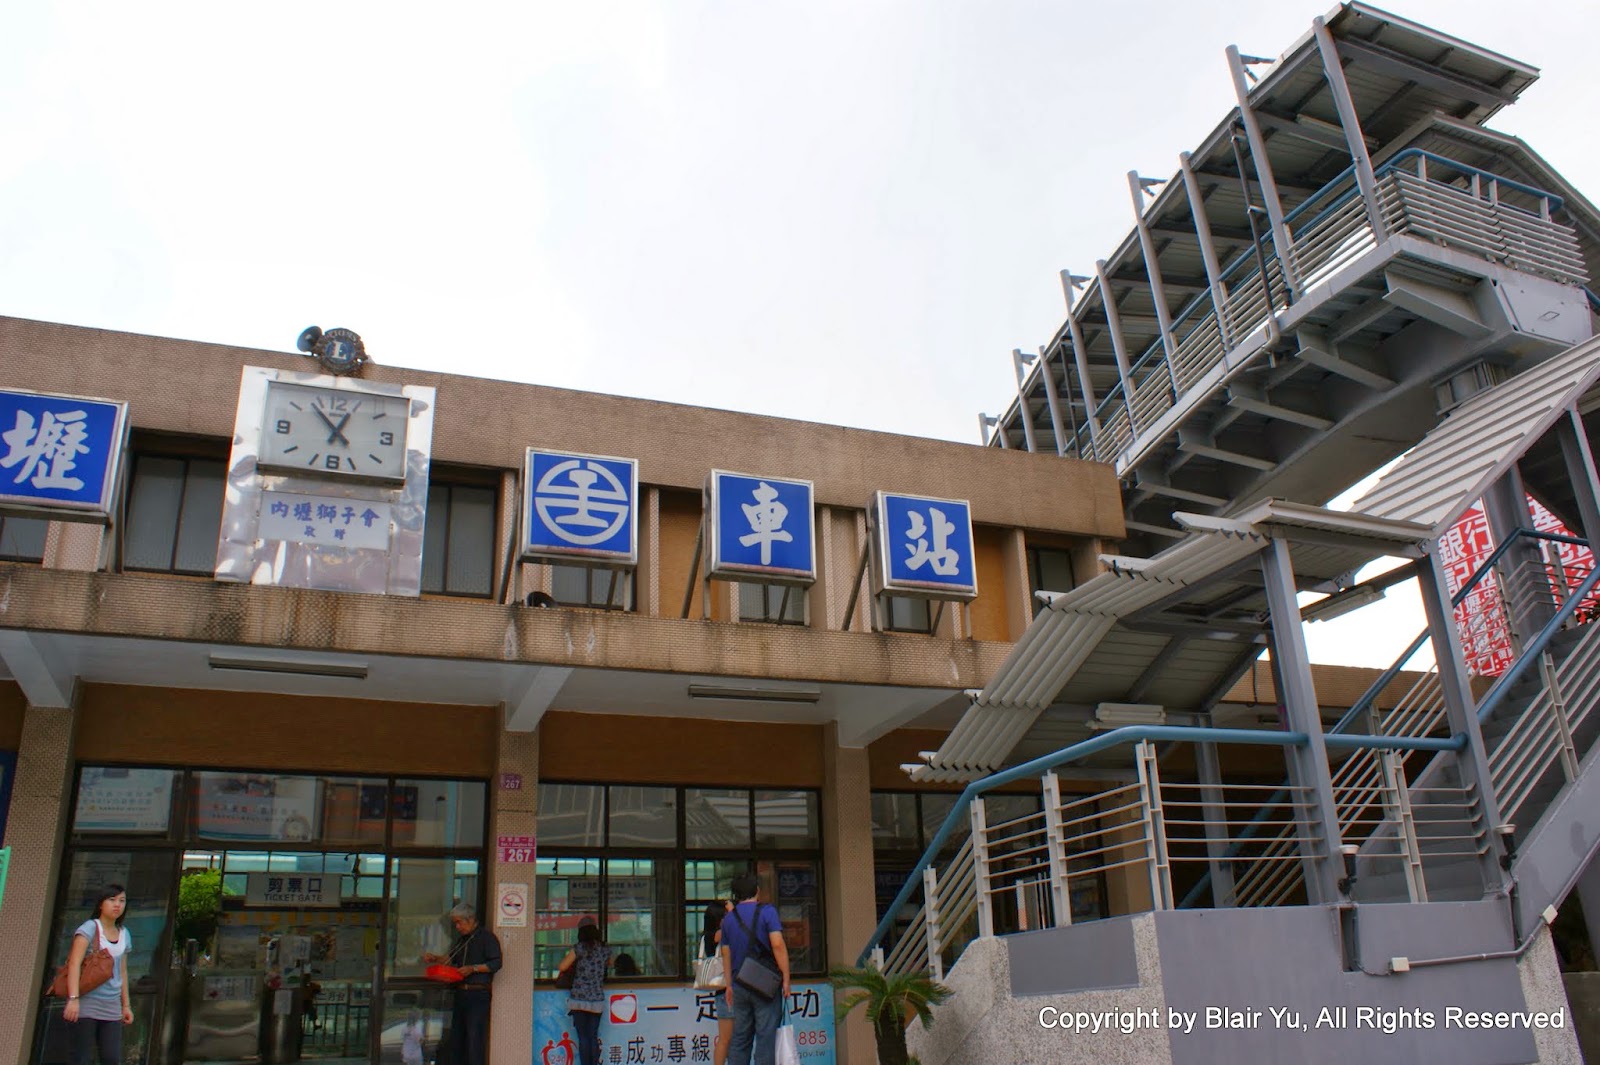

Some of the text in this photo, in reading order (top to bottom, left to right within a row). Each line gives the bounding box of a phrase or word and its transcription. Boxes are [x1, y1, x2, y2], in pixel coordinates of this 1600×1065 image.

[330, 397, 347, 412] 12
[276, 420, 291, 434] 9
[380, 432, 394, 446] 3
[0, 409, 90, 491] 壢
[325, 455, 340, 469] 6
[738, 481, 794, 566] 車
[903, 506, 961, 576] 站
[505, 779, 520, 789] 267
[508, 849, 532, 862] 267
[268, 878, 322, 893] 剪票口
[264, 893, 323, 902] TICKET GATE
